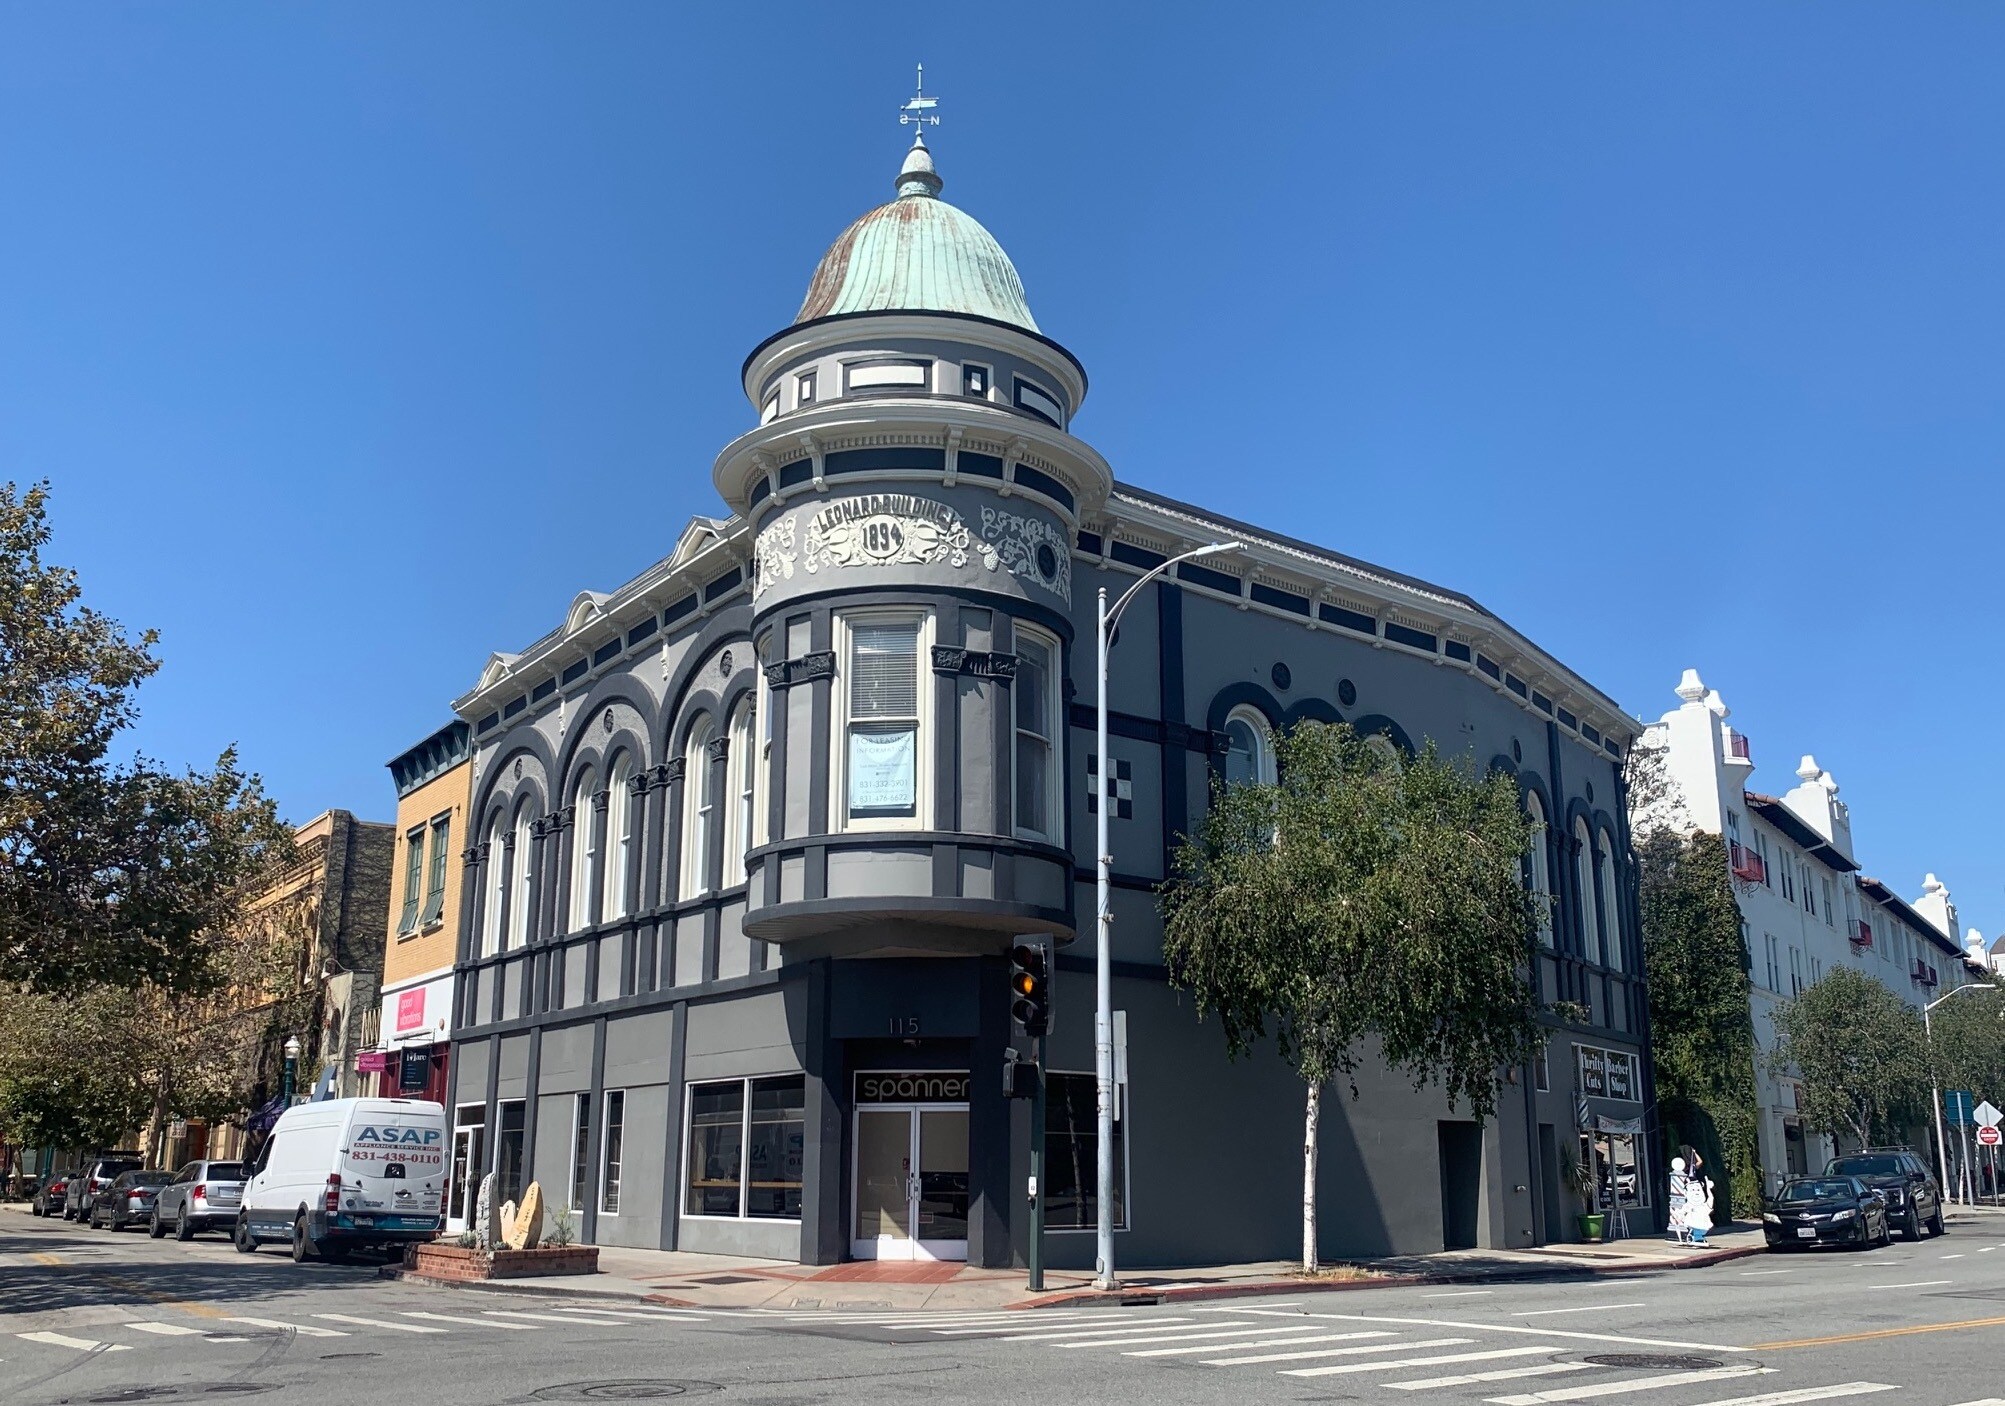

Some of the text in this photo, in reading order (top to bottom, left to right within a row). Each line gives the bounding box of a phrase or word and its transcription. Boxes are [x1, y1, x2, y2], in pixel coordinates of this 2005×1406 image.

[930, 115, 940, 126] N
[817, 495, 954, 533] LEONARD BUILDING
[862, 522, 903, 552] 1894
[889, 1017, 919, 1035] 115
[863, 1078, 970, 1102] spanner
[1586, 1072, 1602, 1090] Cuts
[357, 1126, 440, 1144] ASAP
[352, 1150, 440, 1164] 831-438-0110
